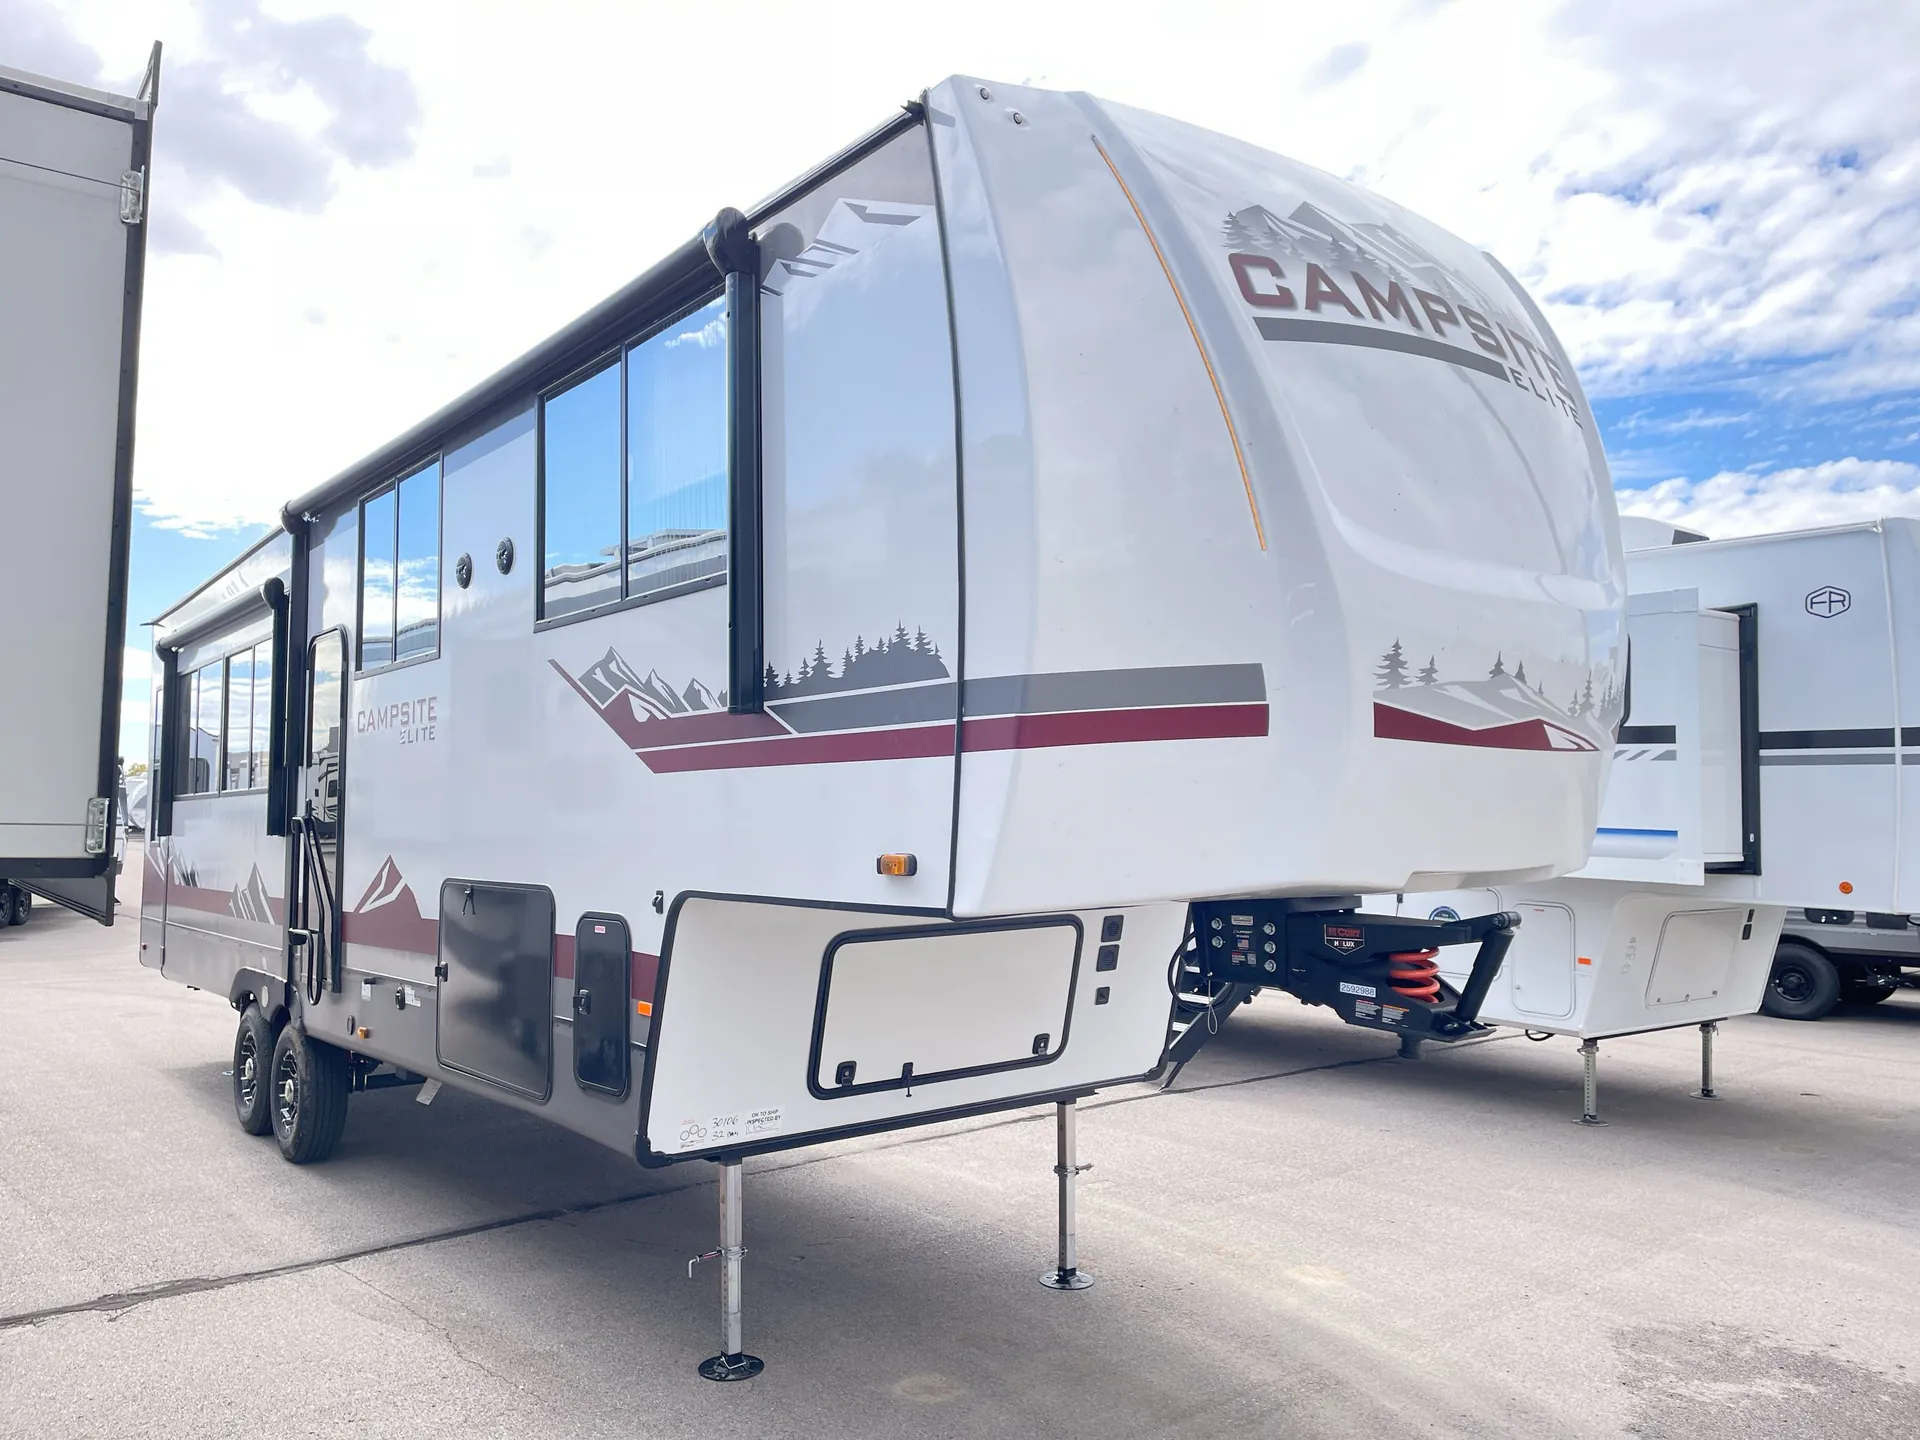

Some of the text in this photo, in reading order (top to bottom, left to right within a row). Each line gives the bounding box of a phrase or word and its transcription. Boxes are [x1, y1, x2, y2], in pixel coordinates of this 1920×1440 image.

[1228, 252, 1578, 409] CAMPSITE
[1508, 366, 1584, 430] ELITE
[357, 696, 437, 733] CAMPSITE
[400, 725, 436, 744] ELITE
[1341, 983, 1376, 996] 2592988
[746, 1116, 774, 1124] INSPECTED
